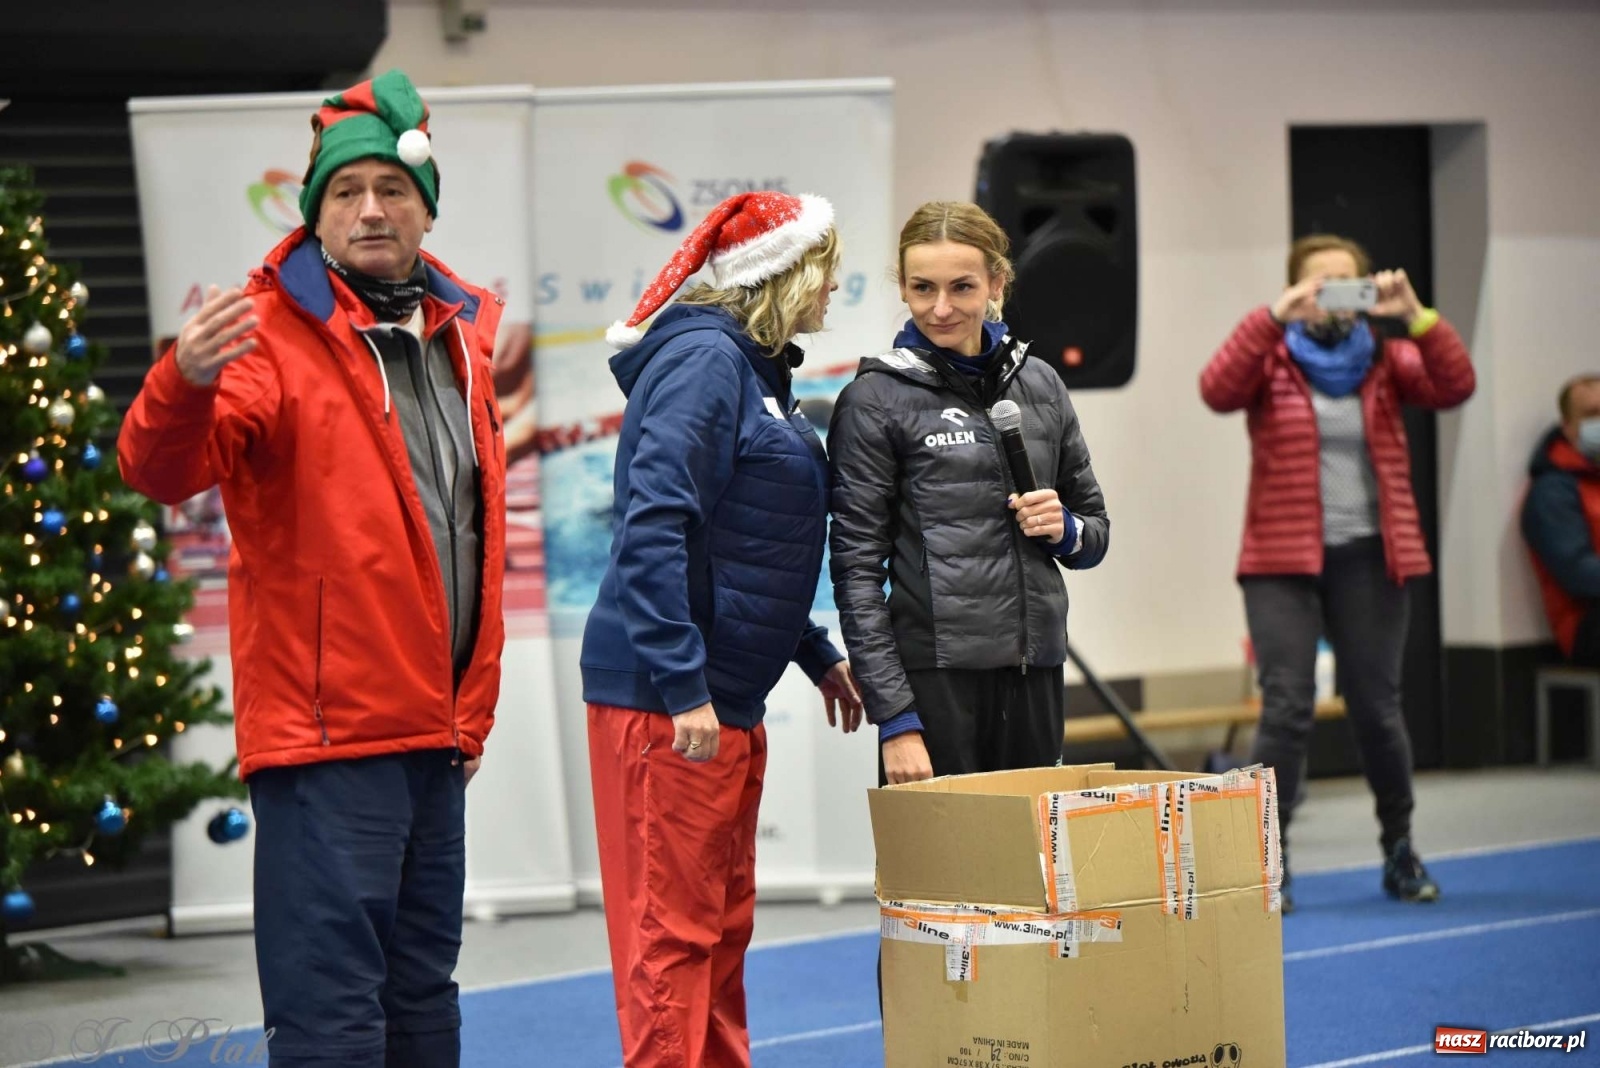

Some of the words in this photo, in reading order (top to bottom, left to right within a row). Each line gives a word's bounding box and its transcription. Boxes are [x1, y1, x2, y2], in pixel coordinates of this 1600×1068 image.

[924, 430, 976, 447] ORLEN
[993, 919, 1068, 940] www.3line.pl
[972, 1036, 996, 1047] CHINA
[996, 1039, 1005, 1048] IN
[1006, 1040, 1030, 1050] MADE
